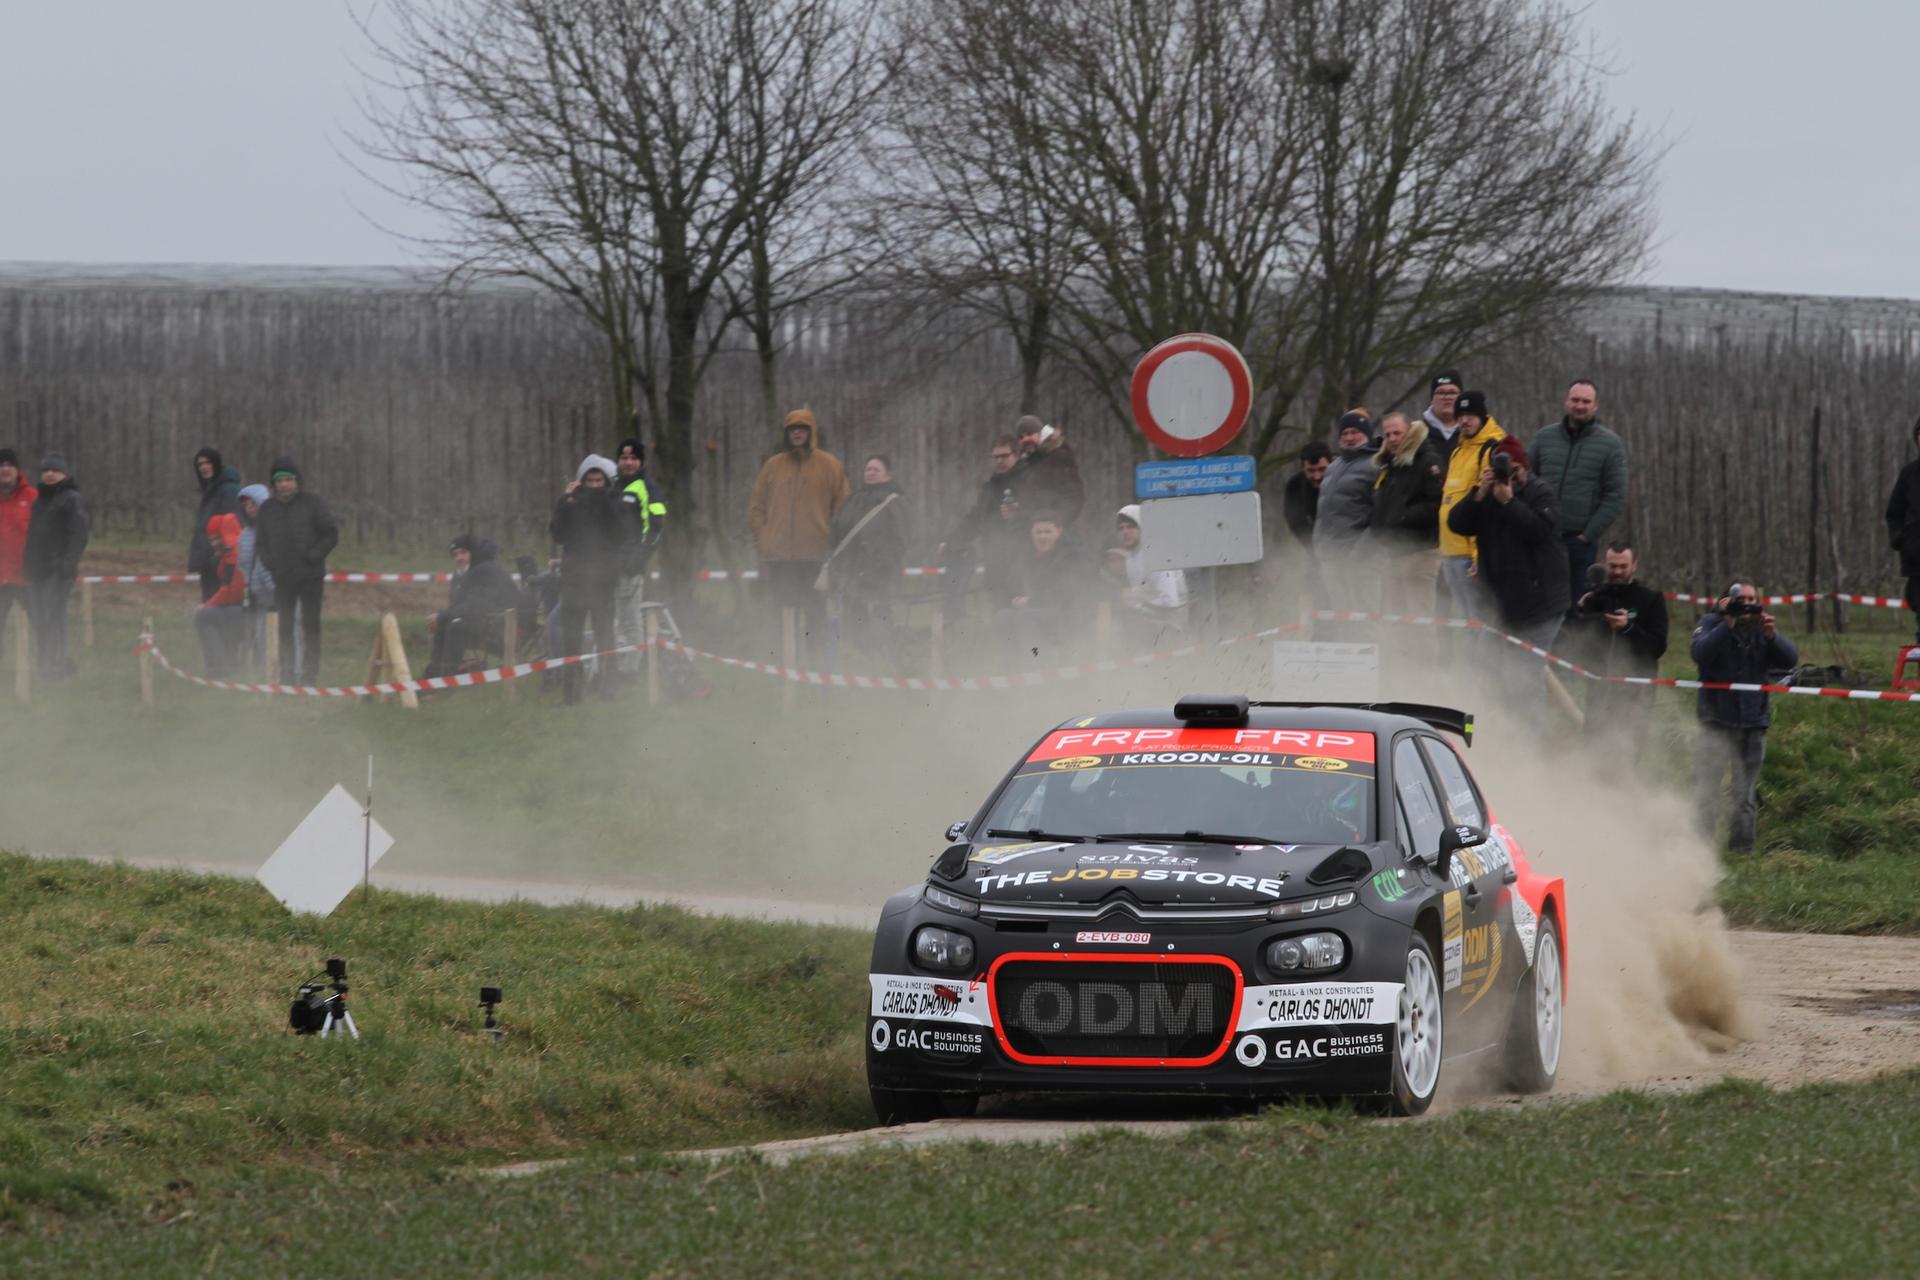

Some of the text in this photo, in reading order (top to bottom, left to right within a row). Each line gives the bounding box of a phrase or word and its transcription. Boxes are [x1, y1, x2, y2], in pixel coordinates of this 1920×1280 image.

[1055, 729, 1355, 750] FRP FRP
[1200, 743, 1271, 752] PRODUCTS
[1122, 752, 1273, 765] KROON-OIL
[1078, 853, 1199, 864] solvas
[1078, 932, 1149, 943] 2-EVB-080
[1464, 924, 1488, 965] ODM
[1306, 988, 1323, 996] INOX
[1325, 986, 1374, 995] CONSTRUCTIES
[882, 991, 919, 1015] CARLOS
[1019, 981, 1213, 1035] ODM
[1268, 997, 1374, 1021] CARLOS DHONDT
[896, 1028, 932, 1050] GAC
[1275, 1038, 1328, 1059] GAC
